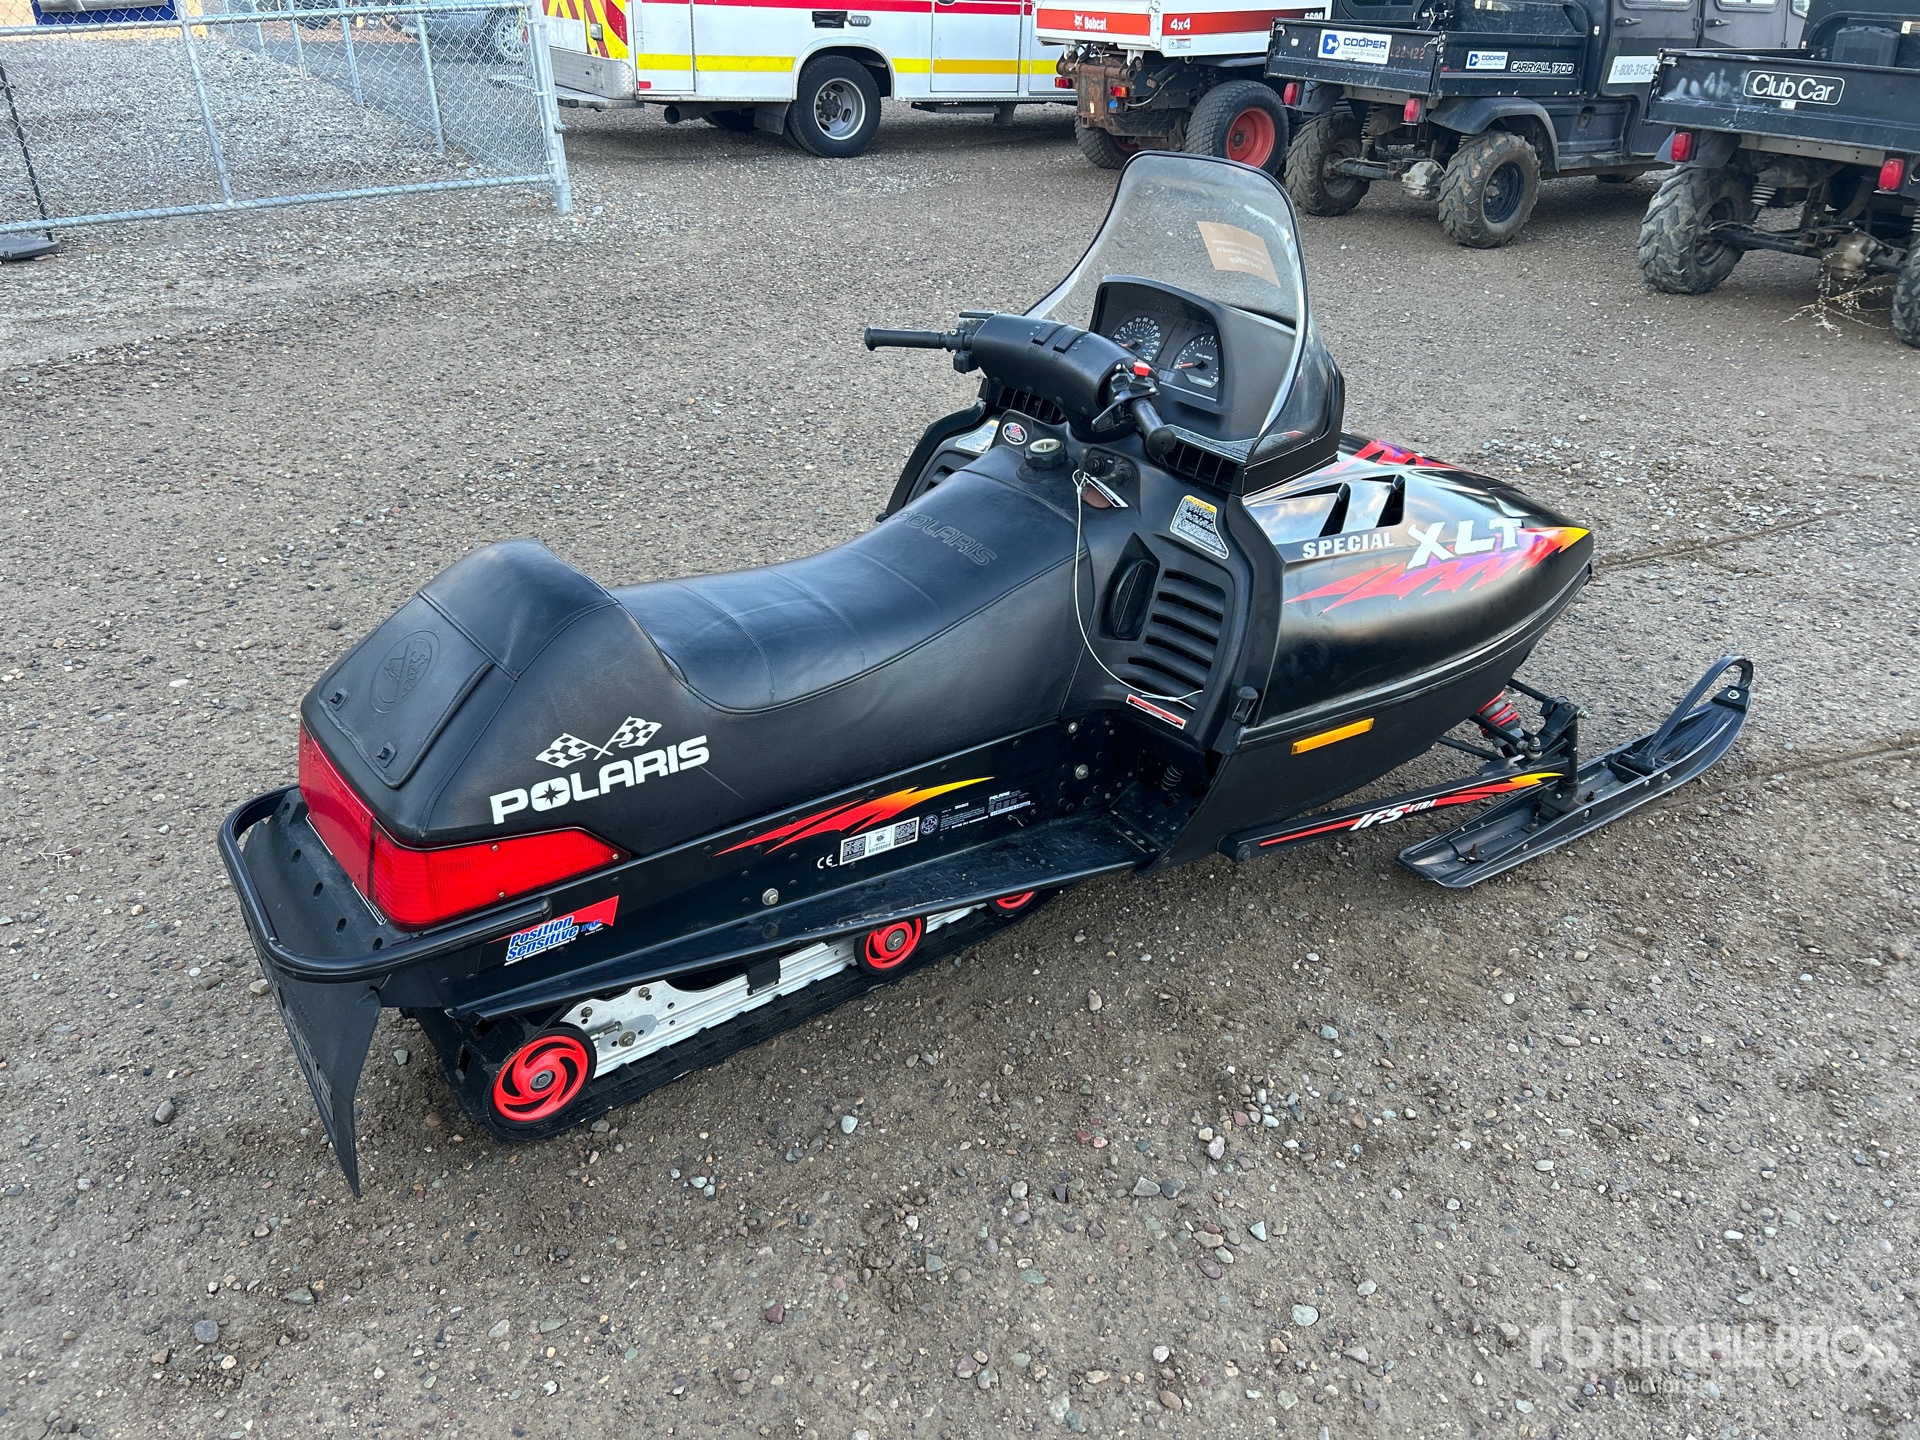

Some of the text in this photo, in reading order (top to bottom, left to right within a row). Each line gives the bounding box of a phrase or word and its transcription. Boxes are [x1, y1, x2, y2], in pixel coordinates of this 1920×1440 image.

[1084, 16, 1107, 31] Bobcat
[1170, 17, 1191, 31] 4x4
[1343, 36, 1387, 50] COOPER
[1510, 60, 1575, 74] CARRYALL 1700
[1613, 63, 1657, 76] 1-800-315-C
[1752, 73, 1834, 102] Club Car
[894, 510, 999, 567] POLARIS
[1301, 516, 1525, 570] SPECIAL XLT
[489, 734, 711, 825] POLARIS
[1349, 803, 1412, 832] IFS
[505, 925, 579, 962] Sensitive
[510, 915, 575, 948] Position
